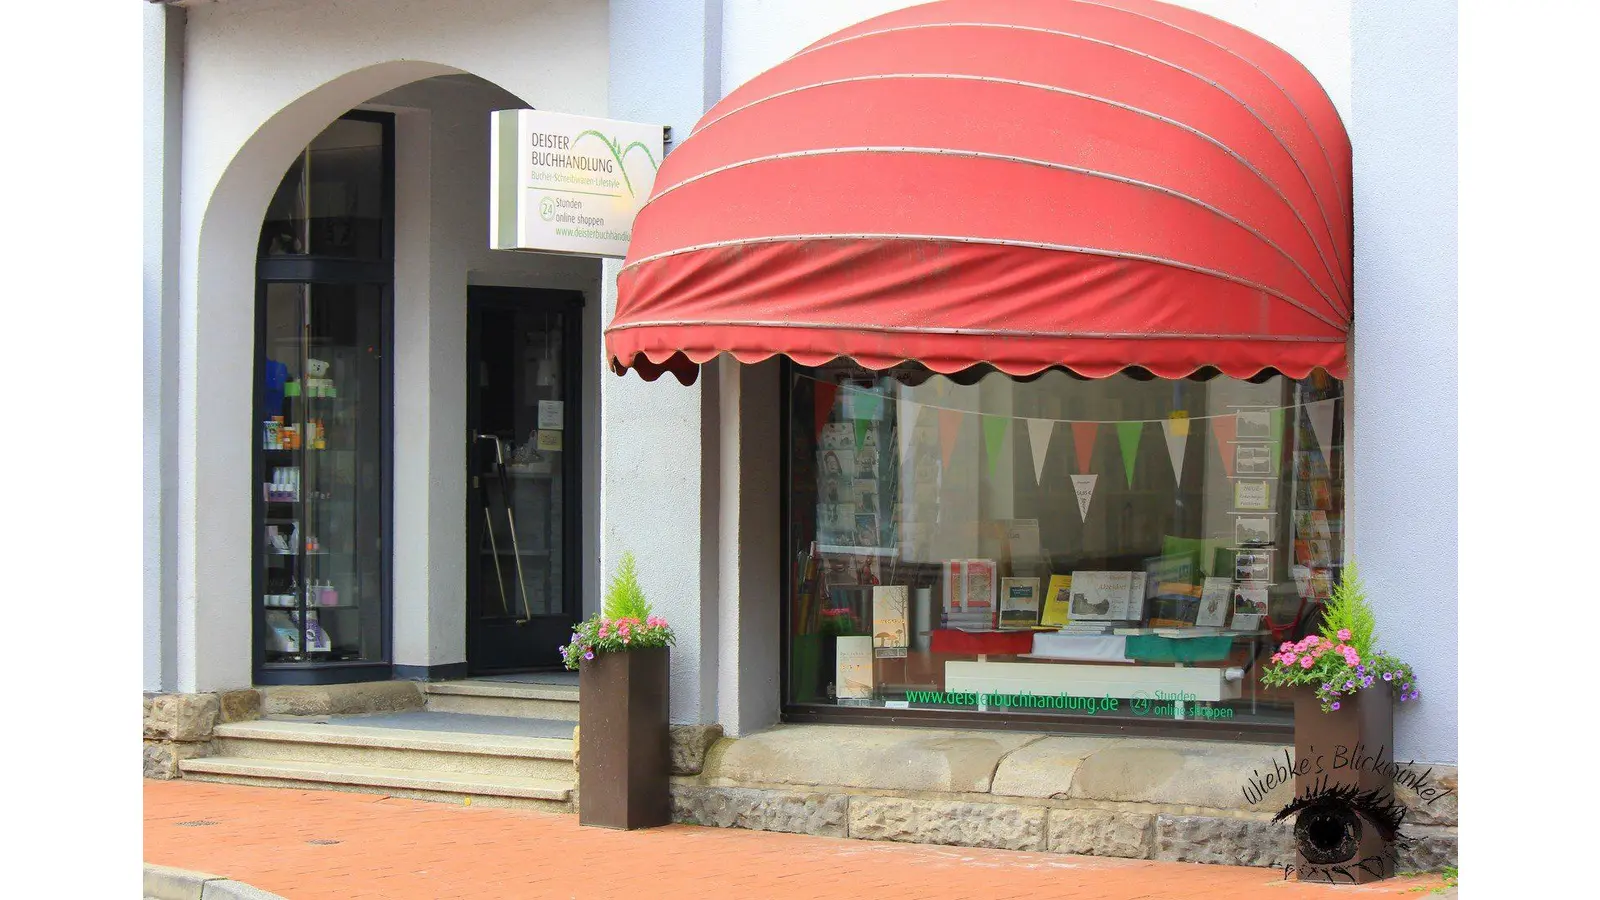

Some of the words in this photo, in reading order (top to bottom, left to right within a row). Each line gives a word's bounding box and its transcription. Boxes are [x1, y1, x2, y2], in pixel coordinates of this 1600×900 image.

[531, 132, 570, 150] DEISTER
[531, 151, 613, 174] BUCHHANDLUNG
[542, 203, 553, 215] 24
[555, 197, 582, 209] Stunden
[555, 213, 576, 224] online
[577, 215, 605, 227] shoppen
[905, 688, 1119, 715] www.deisterbuchhandlung.de
[1154, 690, 1196, 702] Stunden
[1134, 698, 1148, 709] 24
[1154, 703, 1185, 717] online
[1189, 704, 1233, 719] shoppen
